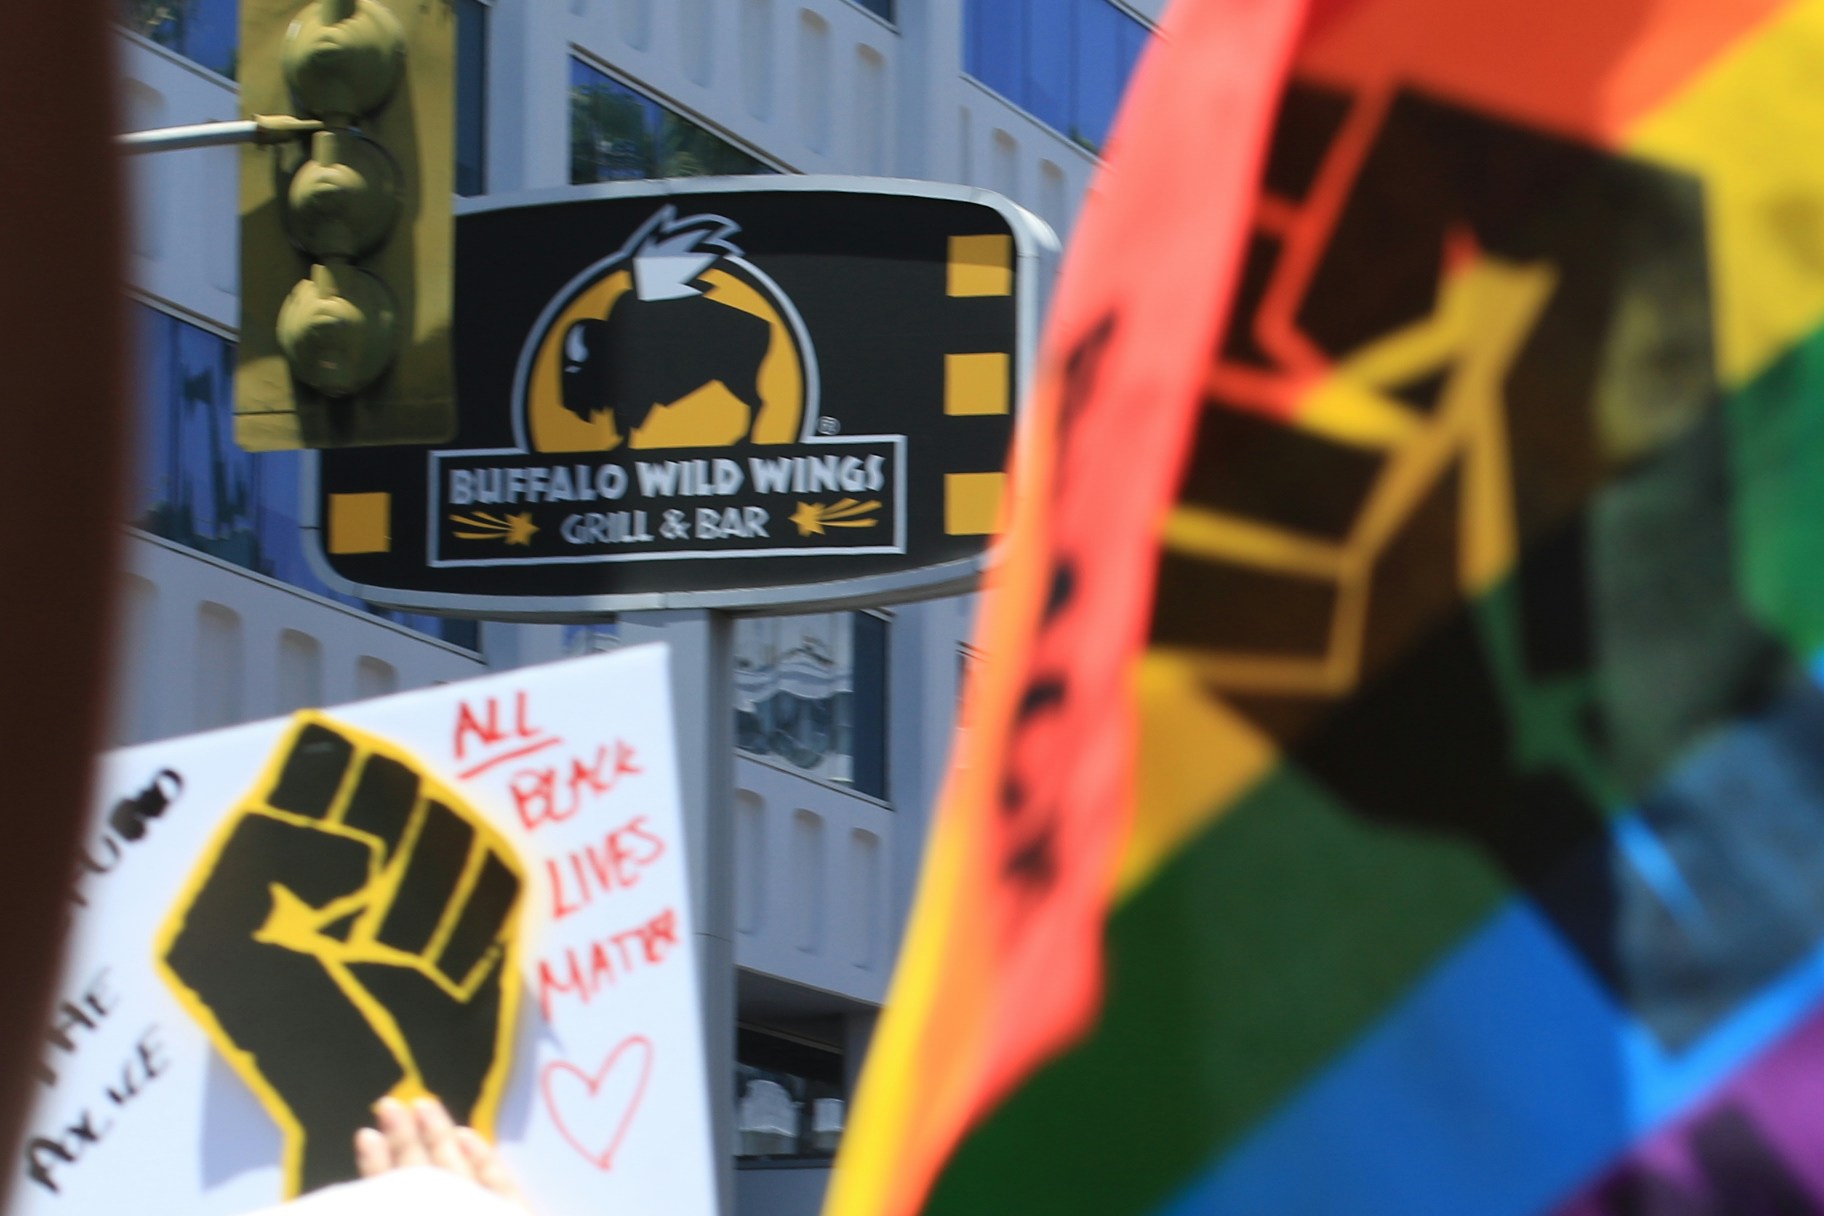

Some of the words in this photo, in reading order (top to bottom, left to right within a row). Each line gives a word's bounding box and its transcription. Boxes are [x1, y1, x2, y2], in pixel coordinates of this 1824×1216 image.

[449, 464, 628, 504] BUFFALO
[635, 458, 745, 498] WILD
[749, 454, 886, 495] WINGS
[560, 509, 655, 546] GRILL
[659, 508, 691, 541] &
[695, 505, 771, 541] BAR
[454, 689, 543, 760] ALL
[508, 738, 645, 832] BLACK
[545, 815, 668, 921] LIVES
